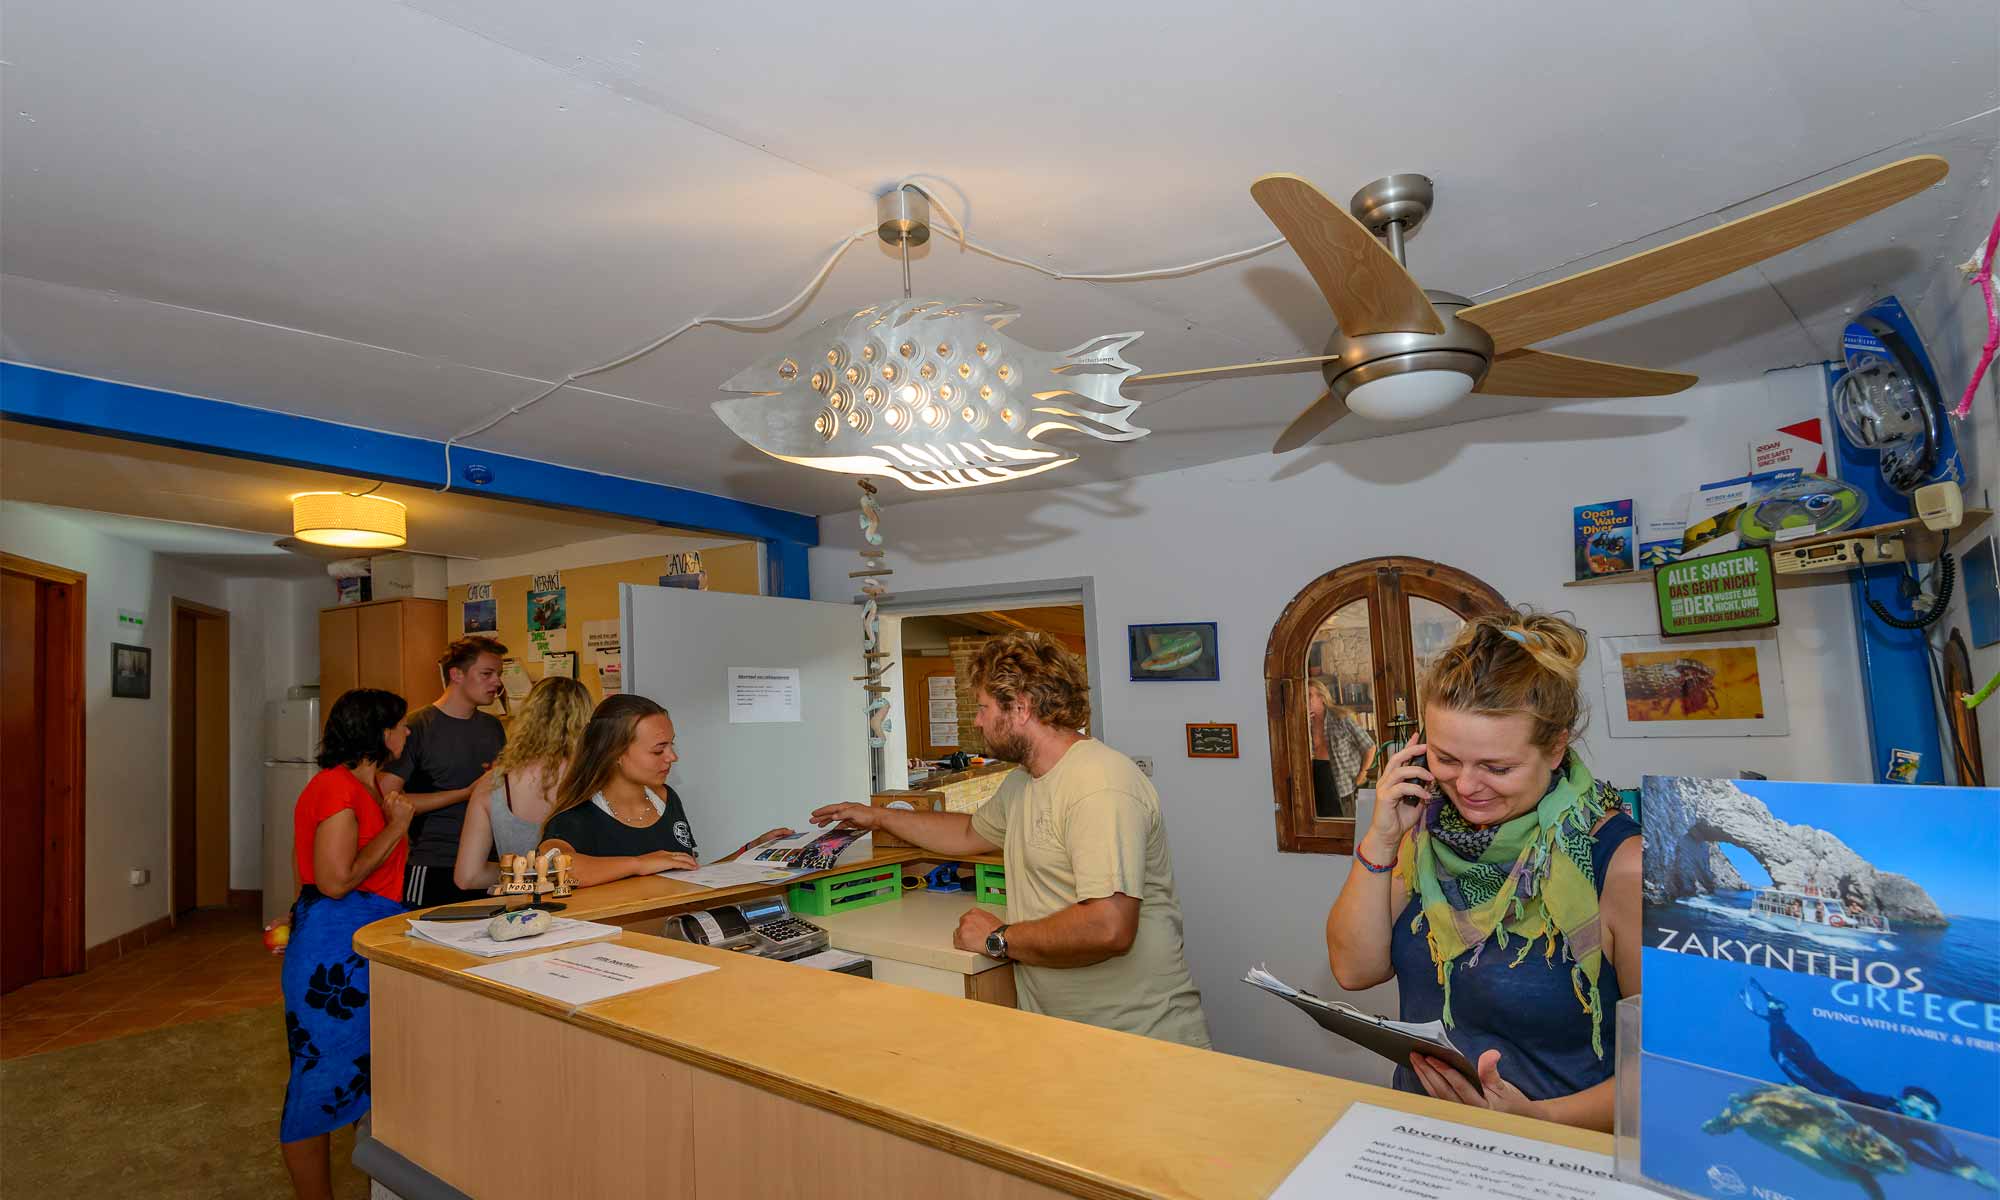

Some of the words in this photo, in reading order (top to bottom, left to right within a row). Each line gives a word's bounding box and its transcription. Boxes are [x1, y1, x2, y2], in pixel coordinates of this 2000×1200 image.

[1582, 509, 1614, 520] Open
[1594, 515, 1628, 526] Water
[1583, 524, 1613, 535] Diver
[1668, 566, 1699, 586] ALLE
[1702, 556, 1759, 580] SAGTEN:
[1669, 584, 1689, 598] DAS
[1692, 579, 1720, 595] GEHT
[1722, 573, 1760, 590] NICHT.
[1743, 588, 1757, 597] DAS
[1684, 594, 1715, 616] DER
[1741, 597, 1758, 608] UND
[1657, 927, 1925, 992] ZAKYNTHOS
[1831, 980, 2000, 1034] GREECE
[1812, 1007, 1859, 1024] DIVING
[1861, 1016, 1898, 1033] WITH
[1901, 1023, 1949, 1042] FAMILY
[1952, 1034, 1963, 1046] &
[1392, 1125, 1496, 1152] Abverkauf
[1502, 1149, 1540, 1162] von
